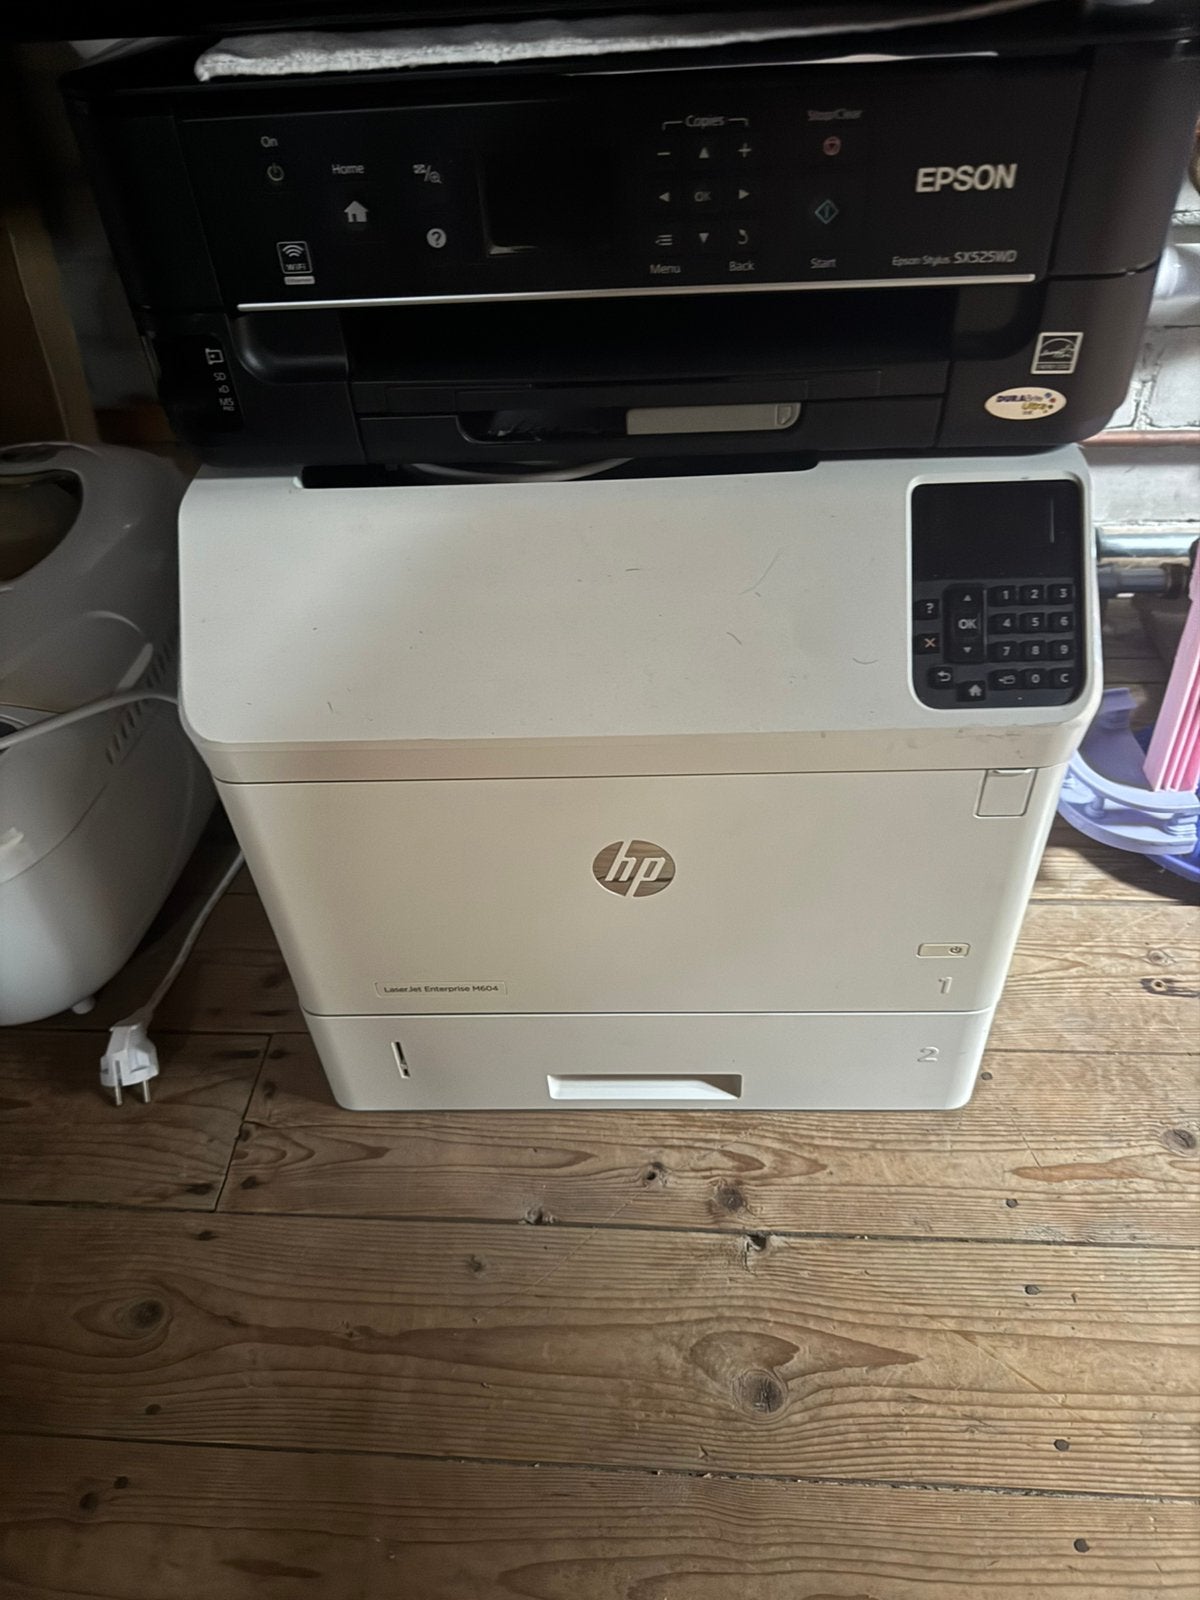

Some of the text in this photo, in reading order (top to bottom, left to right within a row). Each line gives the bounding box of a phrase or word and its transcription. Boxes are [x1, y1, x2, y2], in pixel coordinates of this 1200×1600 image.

[685, 114, 725, 129] Copies
[260, 136, 279, 148] On
[331, 163, 365, 174] Home
[915, 163, 1018, 193] EPSON
[694, 190, 712, 203] OK
[809, 257, 837, 269] Start
[892, 250, 1017, 267] Epson Stylus SX525WD
[649, 264, 681, 274] Menu
[728, 259, 755, 272] Back
[1002, 588, 1068, 600] 1 2 3
[957, 617, 978, 631] OK
[1002, 616, 1069, 629] 4 5 6
[1002, 644, 1069, 657] 7 8 9
[1060, 673, 1069, 684] C
[604, 839, 666, 897] hp
[424, 985, 470, 994] Enterprise
[472, 984, 499, 993] M604
[938, 976, 953, 994] 1
[917, 1046, 939, 1062] 2
